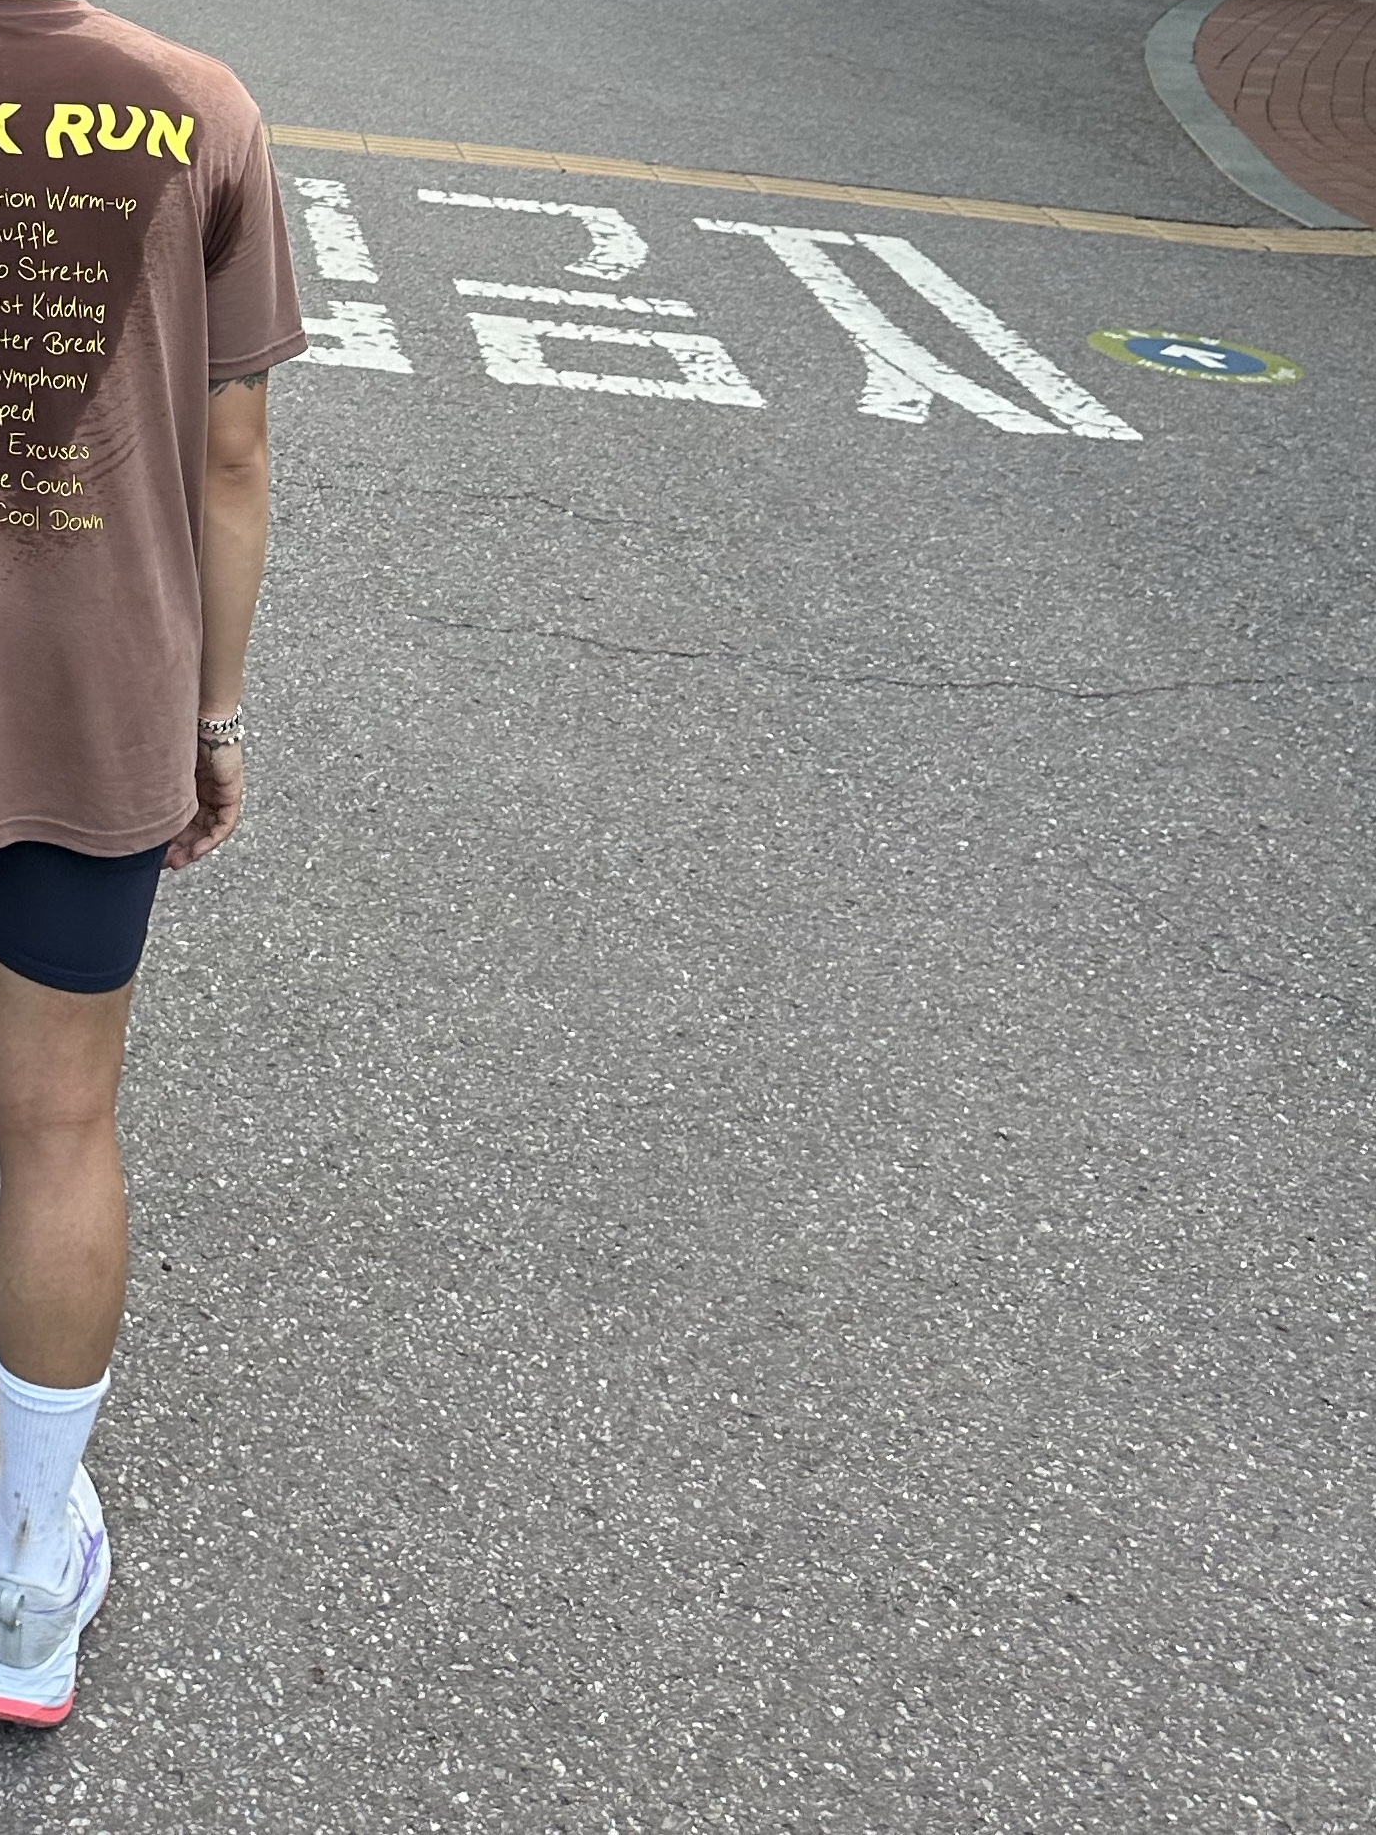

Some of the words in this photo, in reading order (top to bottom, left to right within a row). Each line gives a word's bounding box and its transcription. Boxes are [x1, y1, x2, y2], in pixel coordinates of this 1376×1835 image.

[45, 104, 196, 165] RUN
[46, 187, 137, 219] Warm-up
[18, 257, 108, 283] Stretch
[33, 292, 105, 324] Kidding
[43, 330, 105, 355] Break
[9, 433, 89, 462] Excuses
[21, 470, 83, 496] Couch
[49, 507, 103, 531] Down
